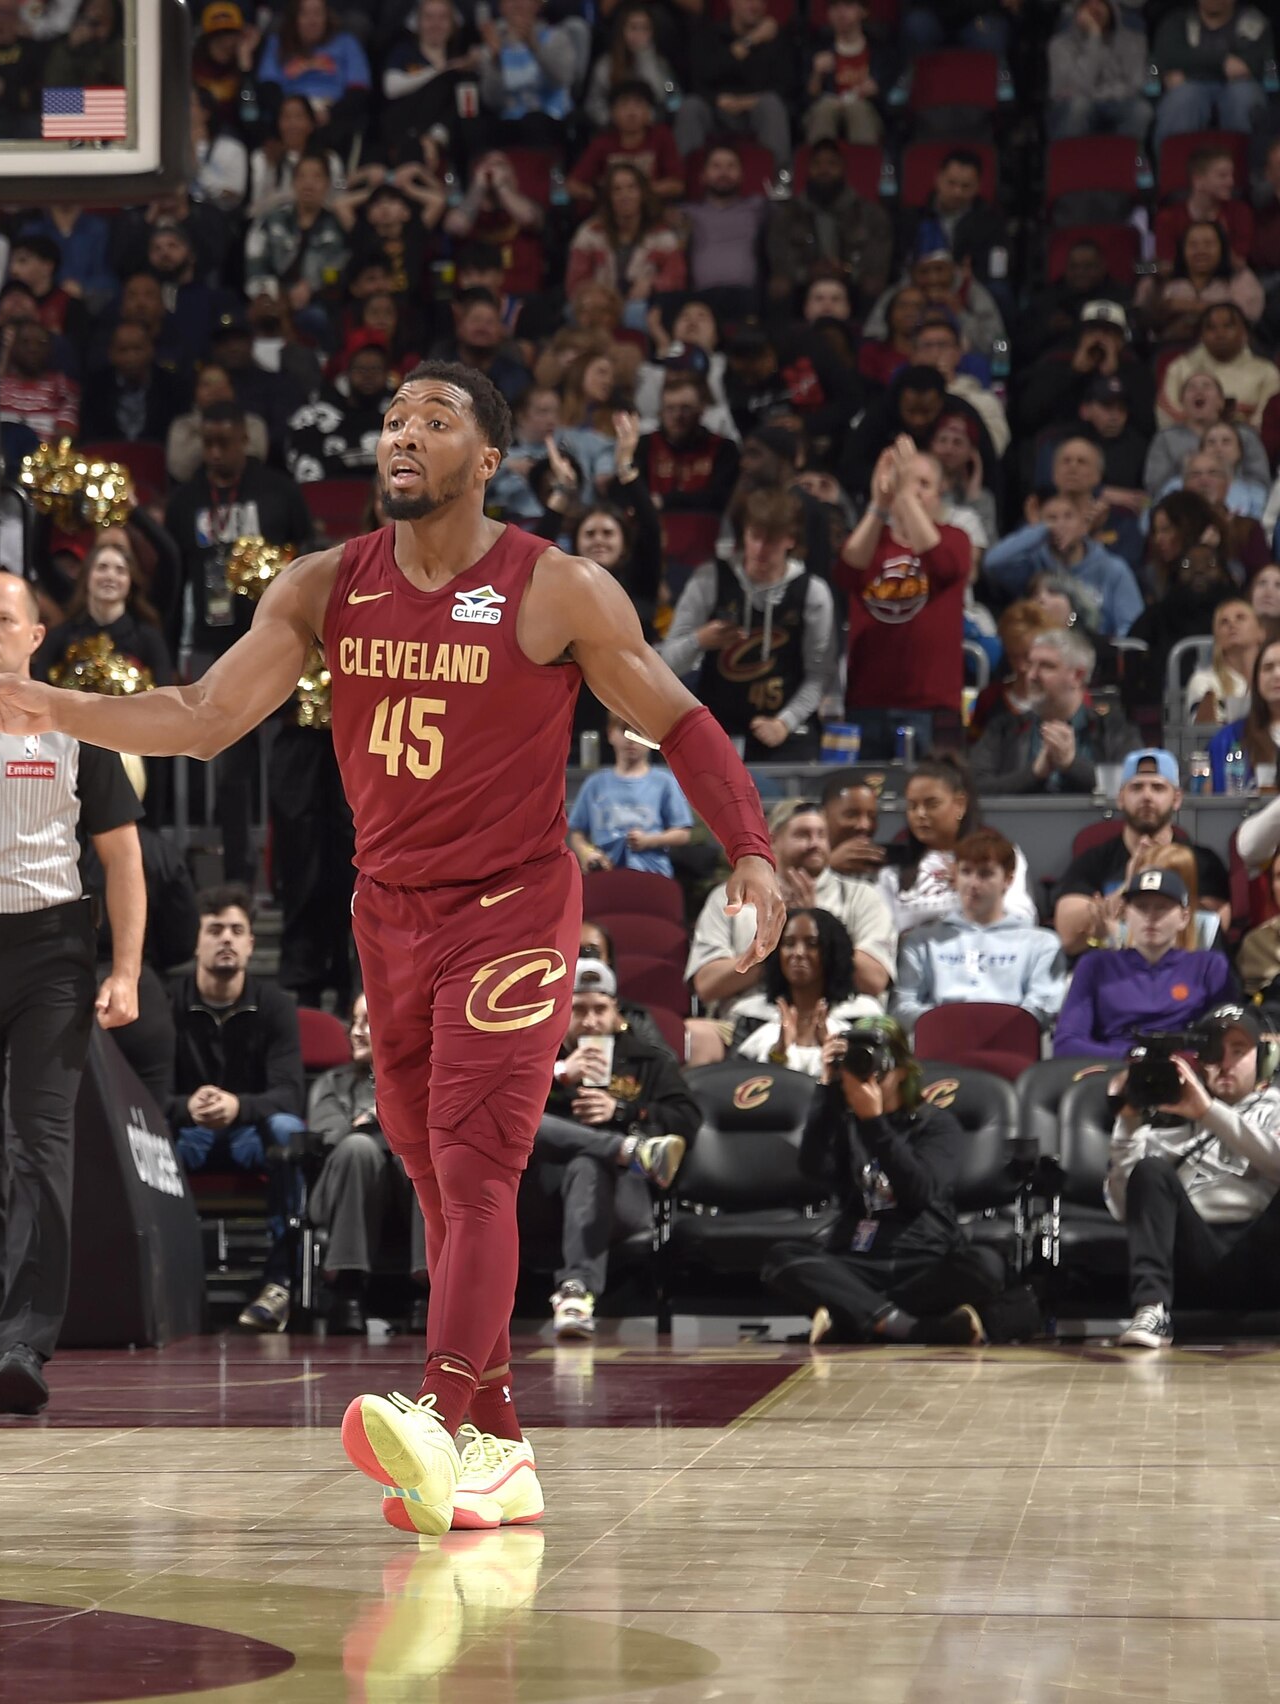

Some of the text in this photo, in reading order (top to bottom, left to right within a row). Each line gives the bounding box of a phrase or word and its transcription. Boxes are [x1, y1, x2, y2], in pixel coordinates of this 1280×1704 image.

[454, 608, 499, 620] CLIFFS
[339, 637, 490, 684] CLEVELAND
[368, 696, 447, 780] 45
[7, 764, 55, 777] Emirates
